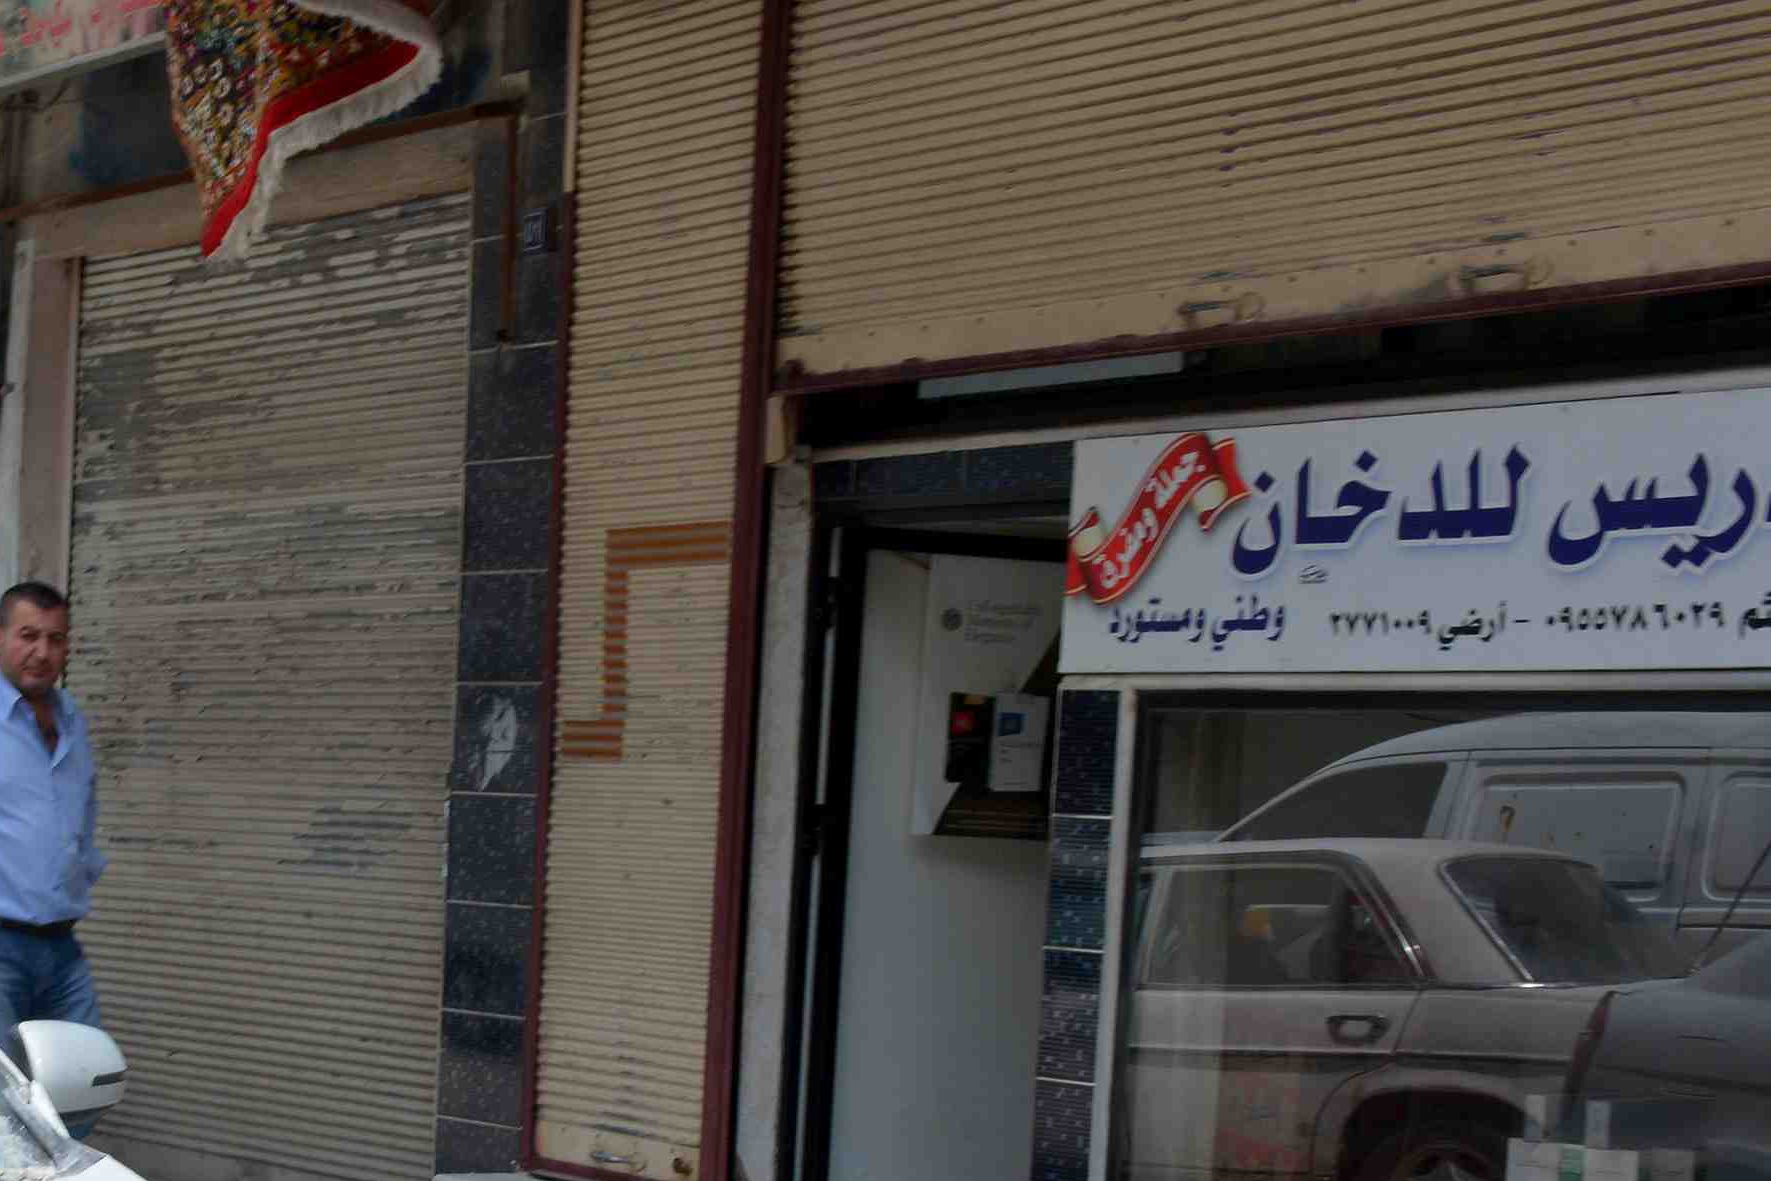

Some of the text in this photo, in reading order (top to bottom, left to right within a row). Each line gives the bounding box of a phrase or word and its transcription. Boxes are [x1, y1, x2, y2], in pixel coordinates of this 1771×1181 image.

[1091, 450, 1206, 589] جملة ومفرق
[1231, 443, 1531, 576] للدخان
[1108, 598, 1206, 645] ومستورد
[1211, 594, 1285, 651] وطني
[1437, 598, 1509, 652] أرضي
